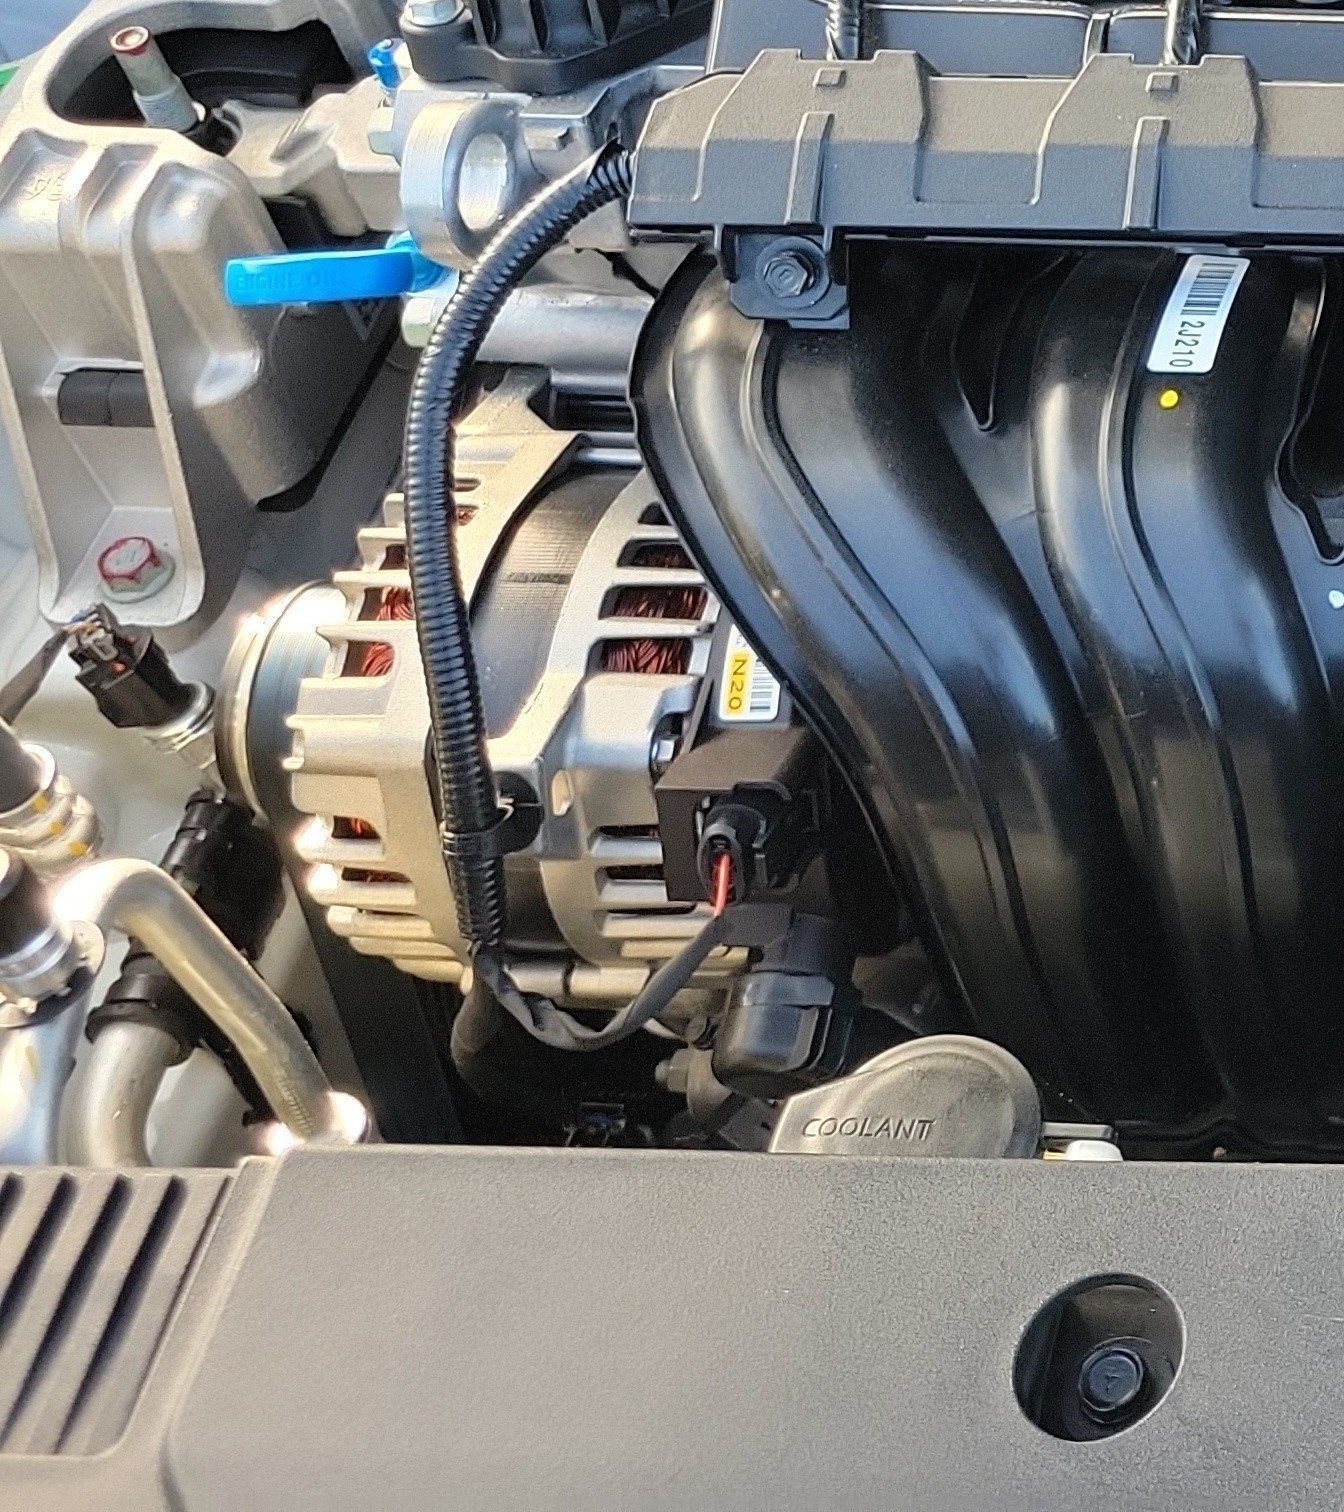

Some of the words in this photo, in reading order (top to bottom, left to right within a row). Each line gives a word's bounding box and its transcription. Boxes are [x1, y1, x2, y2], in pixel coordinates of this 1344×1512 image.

[1168, 320, 1204, 367] 2J210
[727, 658, 747, 713] N20
[801, 1116, 938, 1141] COOLANT
